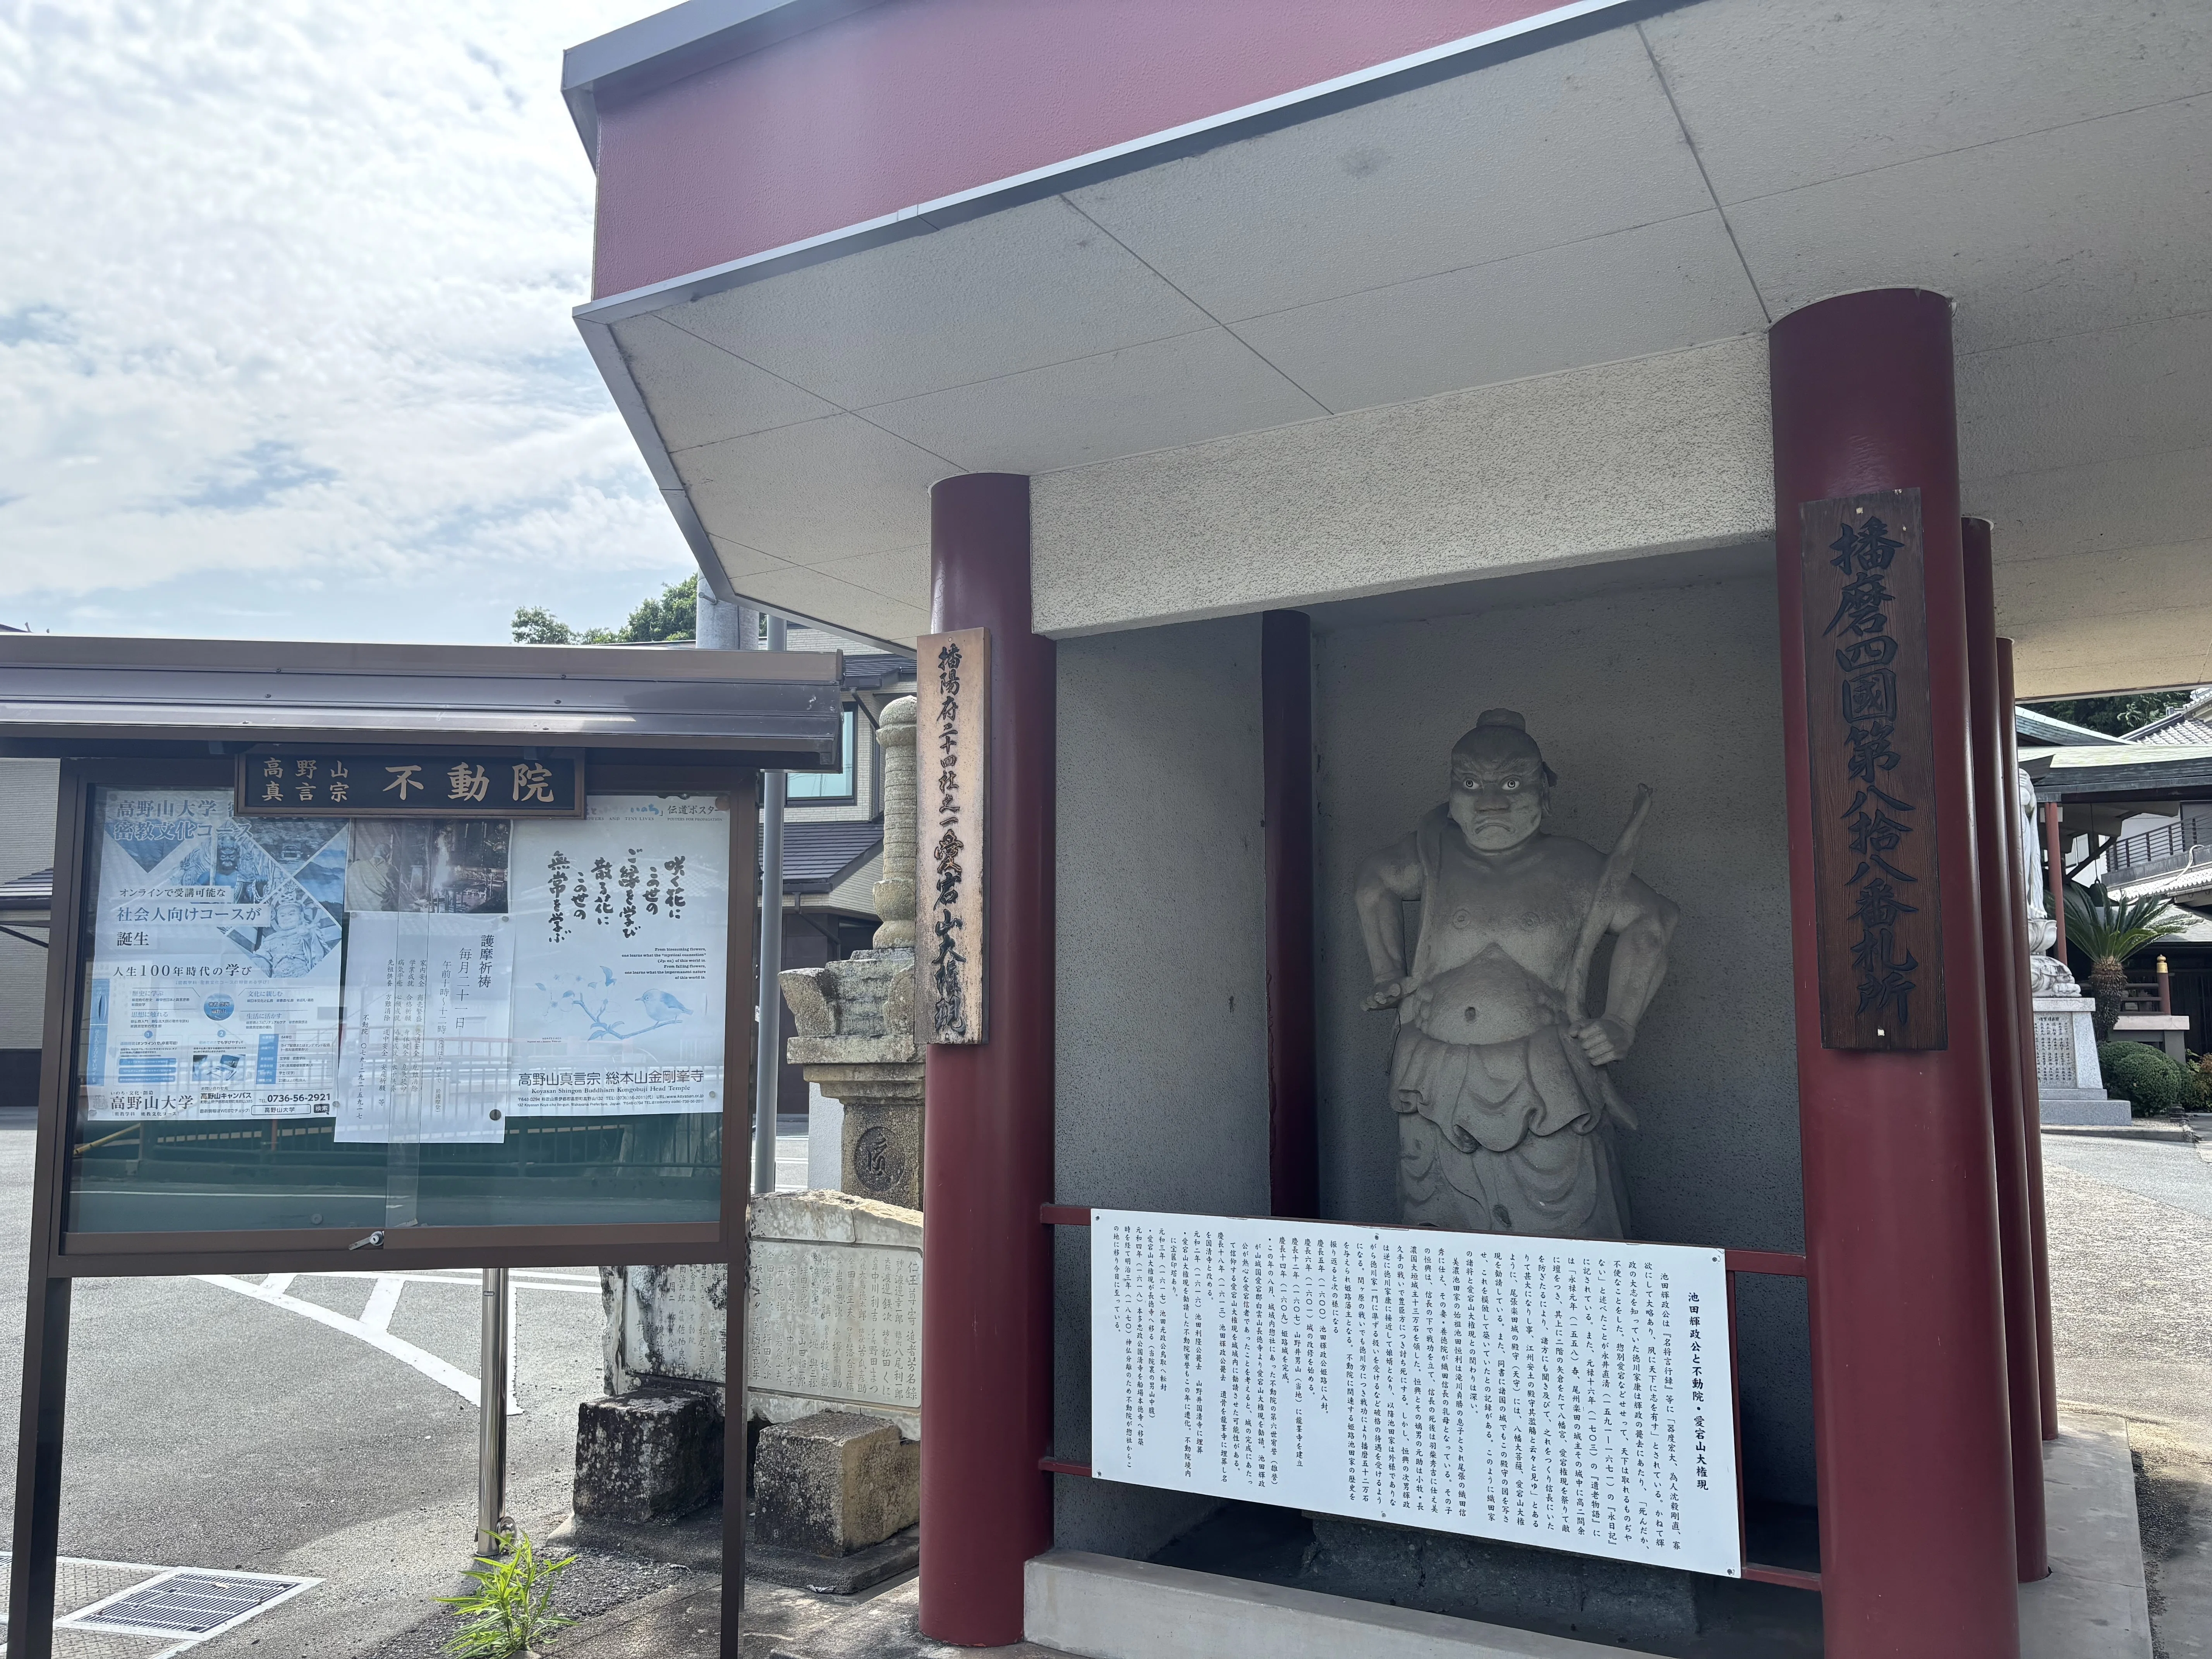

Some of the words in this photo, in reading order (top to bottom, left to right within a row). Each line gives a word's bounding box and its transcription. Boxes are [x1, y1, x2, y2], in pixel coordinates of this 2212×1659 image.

[262, 781, 350, 802] 真言宗
[263, 757, 349, 779] 高野山
[382, 762, 555, 803] 不動院
[1822, 515, 1919, 1026] 播磨四國第八拾八番札所
[114, 821, 253, 841] 密教文化コース
[117, 799, 216, 817] 高野山大学
[120, 888, 226, 897] オンラインで受講可能な
[548, 850, 571, 943] 無常を学ぶ
[570, 872, 589, 920] この世の
[591, 857, 614, 925] 散る花に
[619, 848, 643, 939] ご縁を学び
[642, 866, 661, 915] この世の
[664, 855, 686, 919] 咲く花に
[117, 907, 261, 922] 社会人向けコースが
[117, 932, 149, 946] 誕生
[478, 934, 494, 988] 護摩祈祷
[113, 963, 252, 976] 人生100年時代の学び
[407, 959, 416, 987] 学業成就
[418, 959, 427, 987] 家内安全
[455, 948, 472, 1029] 毎月二十一日
[405, 994, 413, 1022] 合格祈願
[267, 1093, 330, 1103] 0736-56-2921
[518, 1072, 601, 1086] 高野山真言宗
[606, 1069, 704, 1085] 総本山金剛峯寺
[110, 1095, 193, 1109] 高野山大学
[1158, 1228, 1167, 1391] 元和三年（一六一七）池田光政公鳥取へ転封
[1278, 1236, 1289, 1383] 慶長十四年（一六〇九）姫路城を完成。
[1329, 1240, 1339, 1333] 振り返ると次の様になる
[1304, 1238, 1315, 1395] 慶長六年（一六〇一）城の改修を始める。
[1317, 1238, 1328, 1413] 慶長五年（一六〇〇）池田輝政公姫路に入封。
[1465, 1250, 1478, 1413] の諸将と愛宕山大権現との関わりは深い。
[1688, 1291, 1709, 1490] 池田輝政公と不動院・愛宕山大権現
